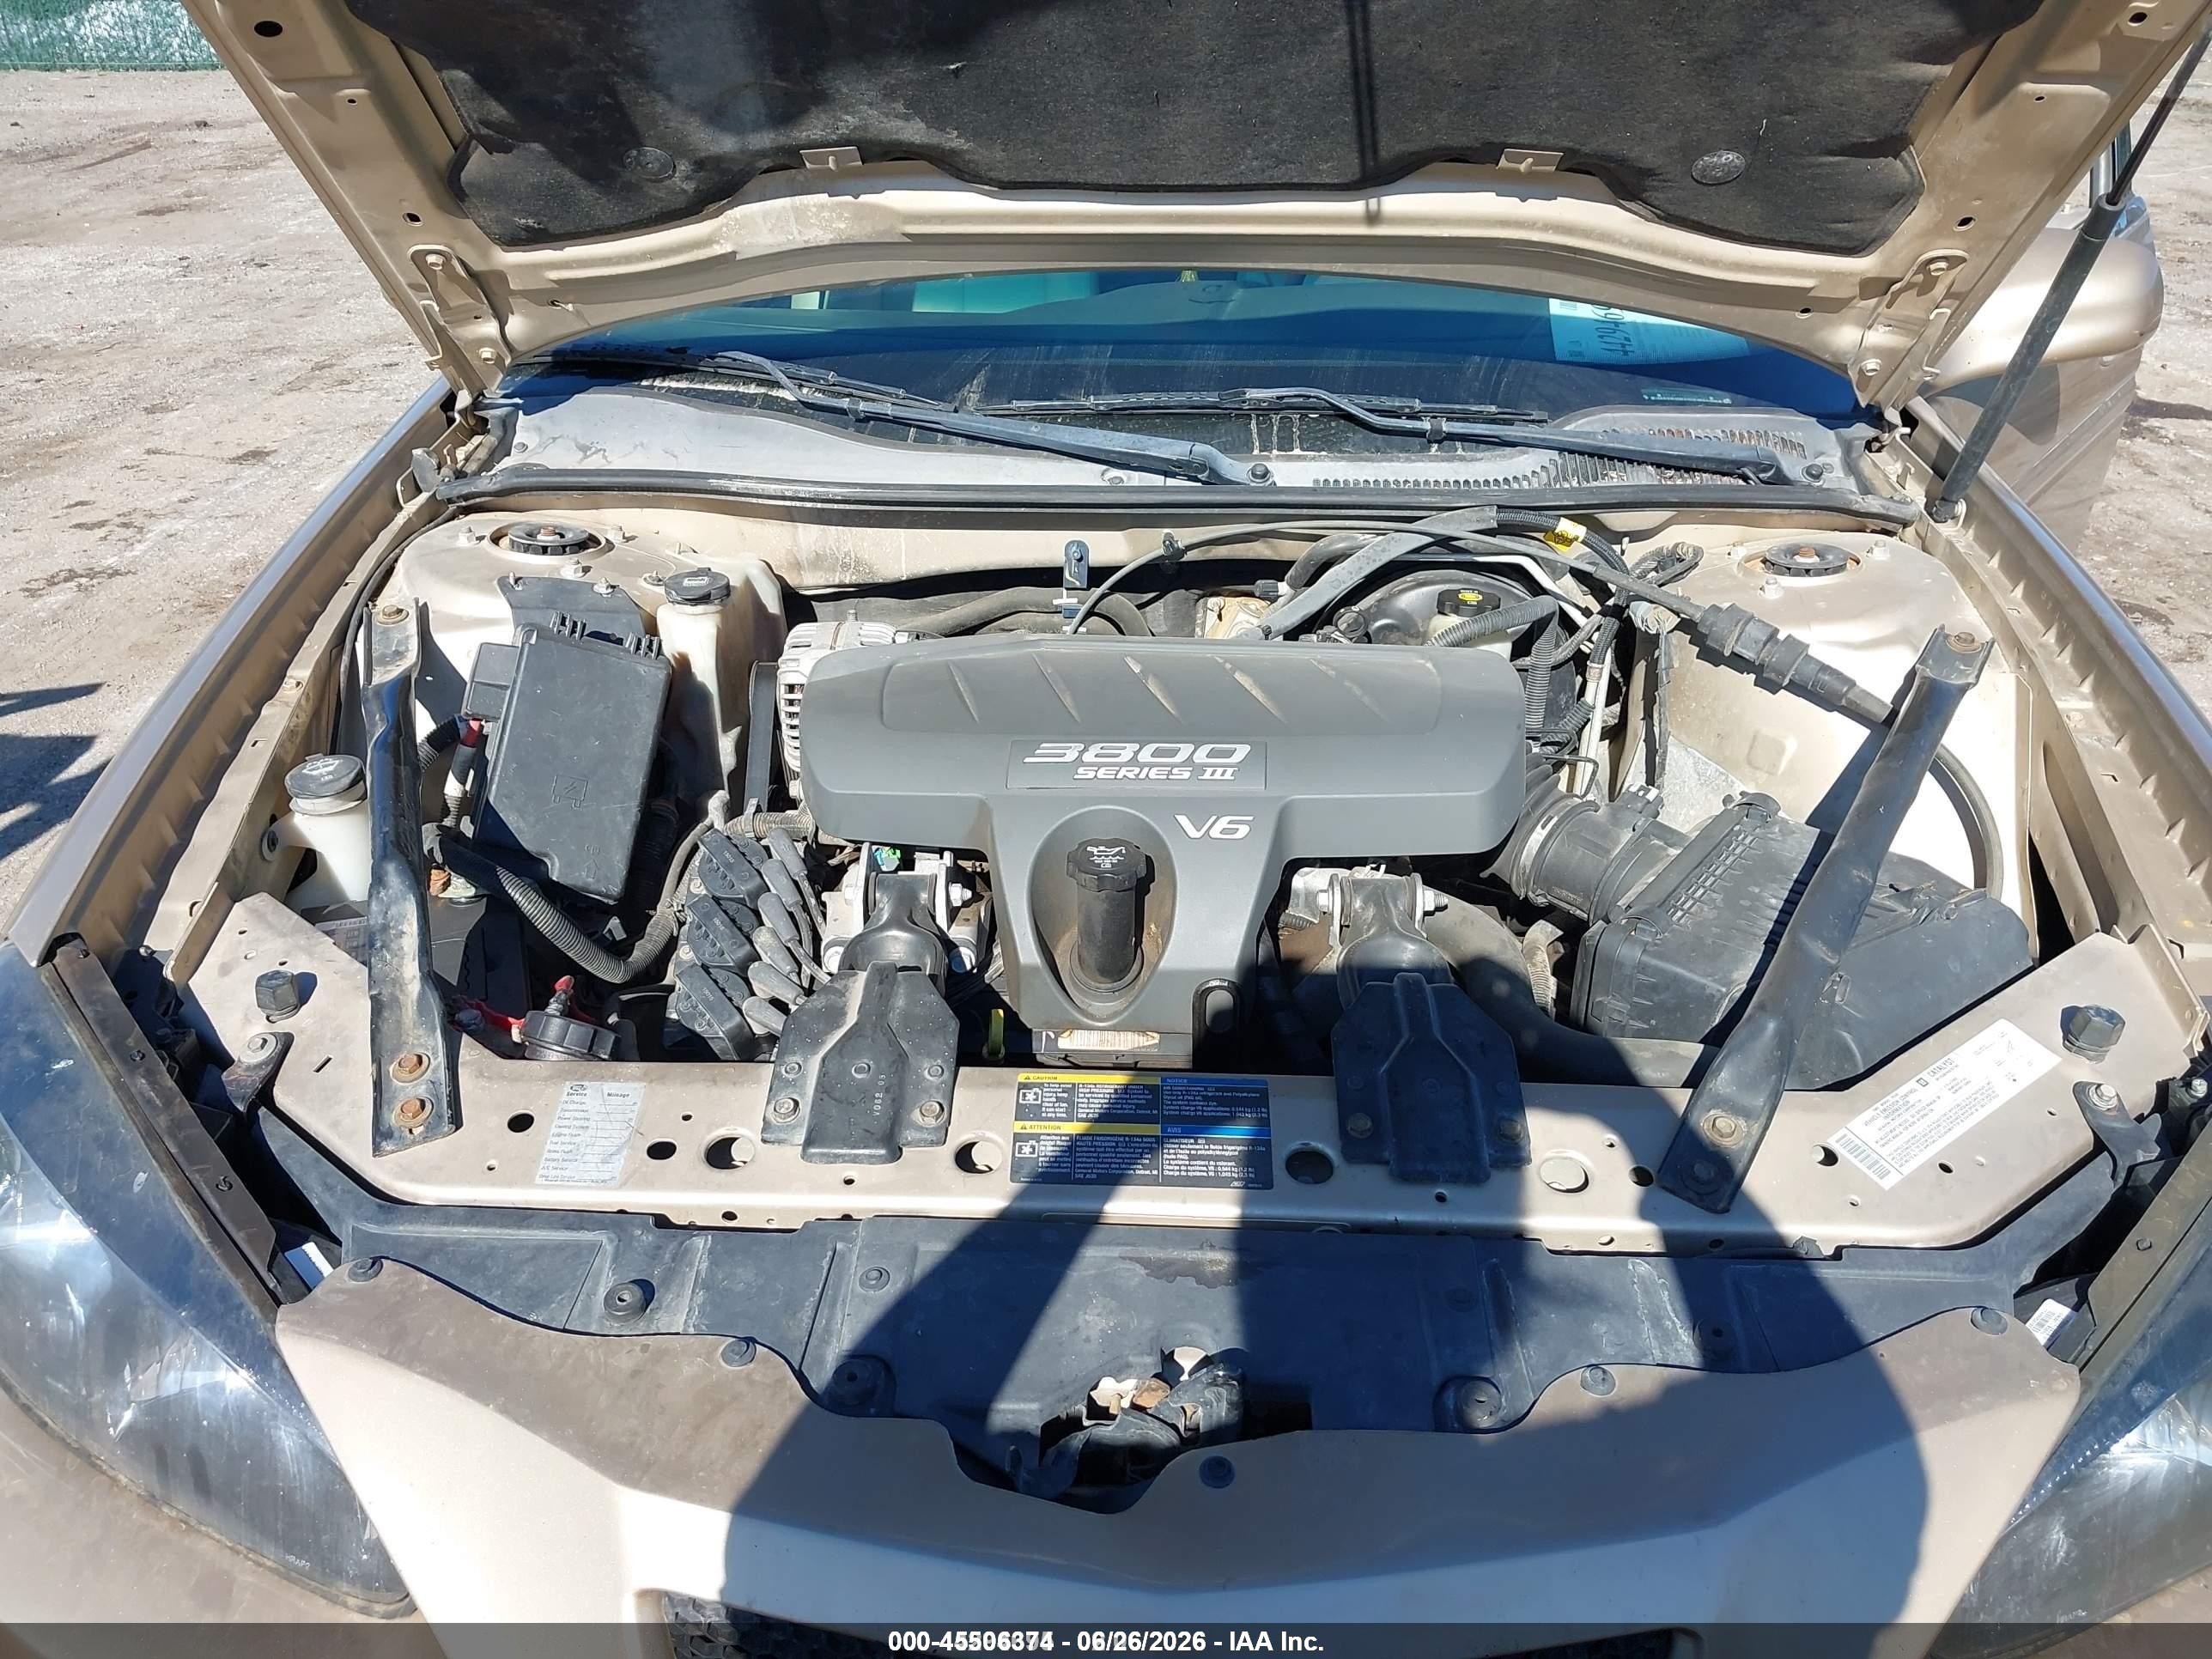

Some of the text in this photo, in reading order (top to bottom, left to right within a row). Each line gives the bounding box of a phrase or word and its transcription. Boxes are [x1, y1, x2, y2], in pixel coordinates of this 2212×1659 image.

[1023, 743, 1251, 763] 3800
[1073, 766, 1239, 781] SERIES III
[1174, 814, 1255, 839] V6
[1926, 1057, 1954, 1077] CATALYST
